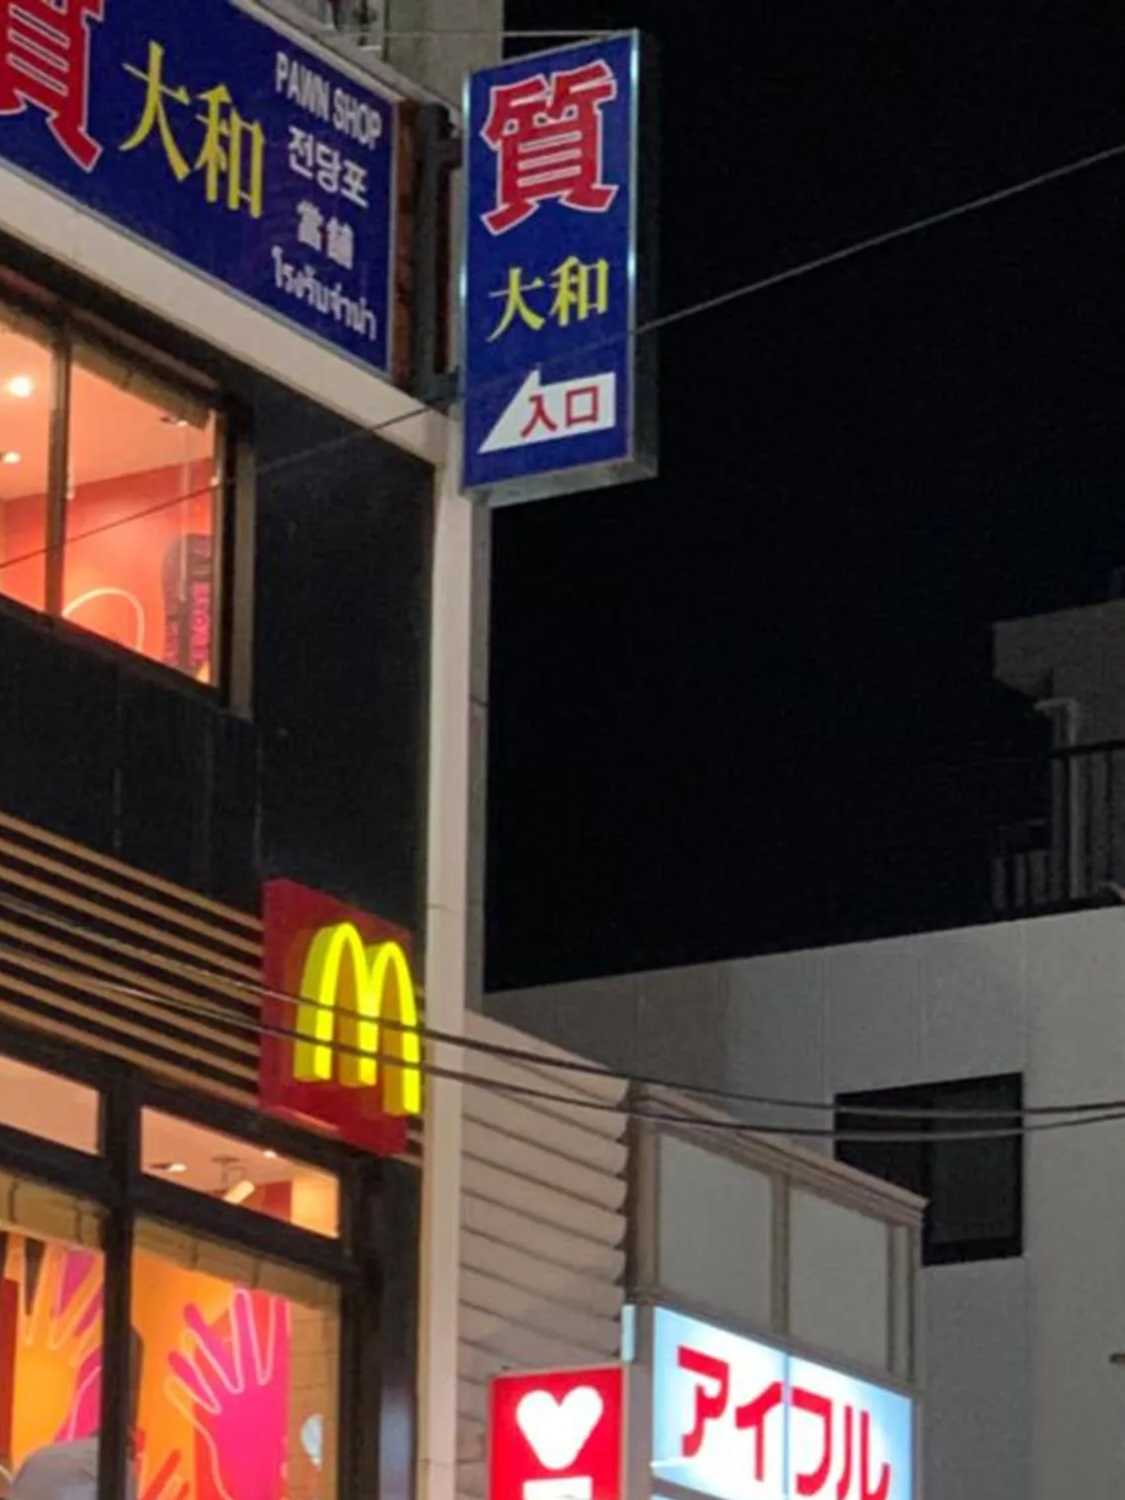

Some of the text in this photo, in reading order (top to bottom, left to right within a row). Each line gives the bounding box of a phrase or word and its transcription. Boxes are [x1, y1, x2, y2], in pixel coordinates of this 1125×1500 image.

[118, 40, 266, 220] 大和
[275, 50, 383, 151] PAWN SHOP
[480, 59, 619, 236] 質
[288, 125, 369, 209] 전당포
[486, 255, 610, 343] 大和
[520, 385, 599, 438] 入口
